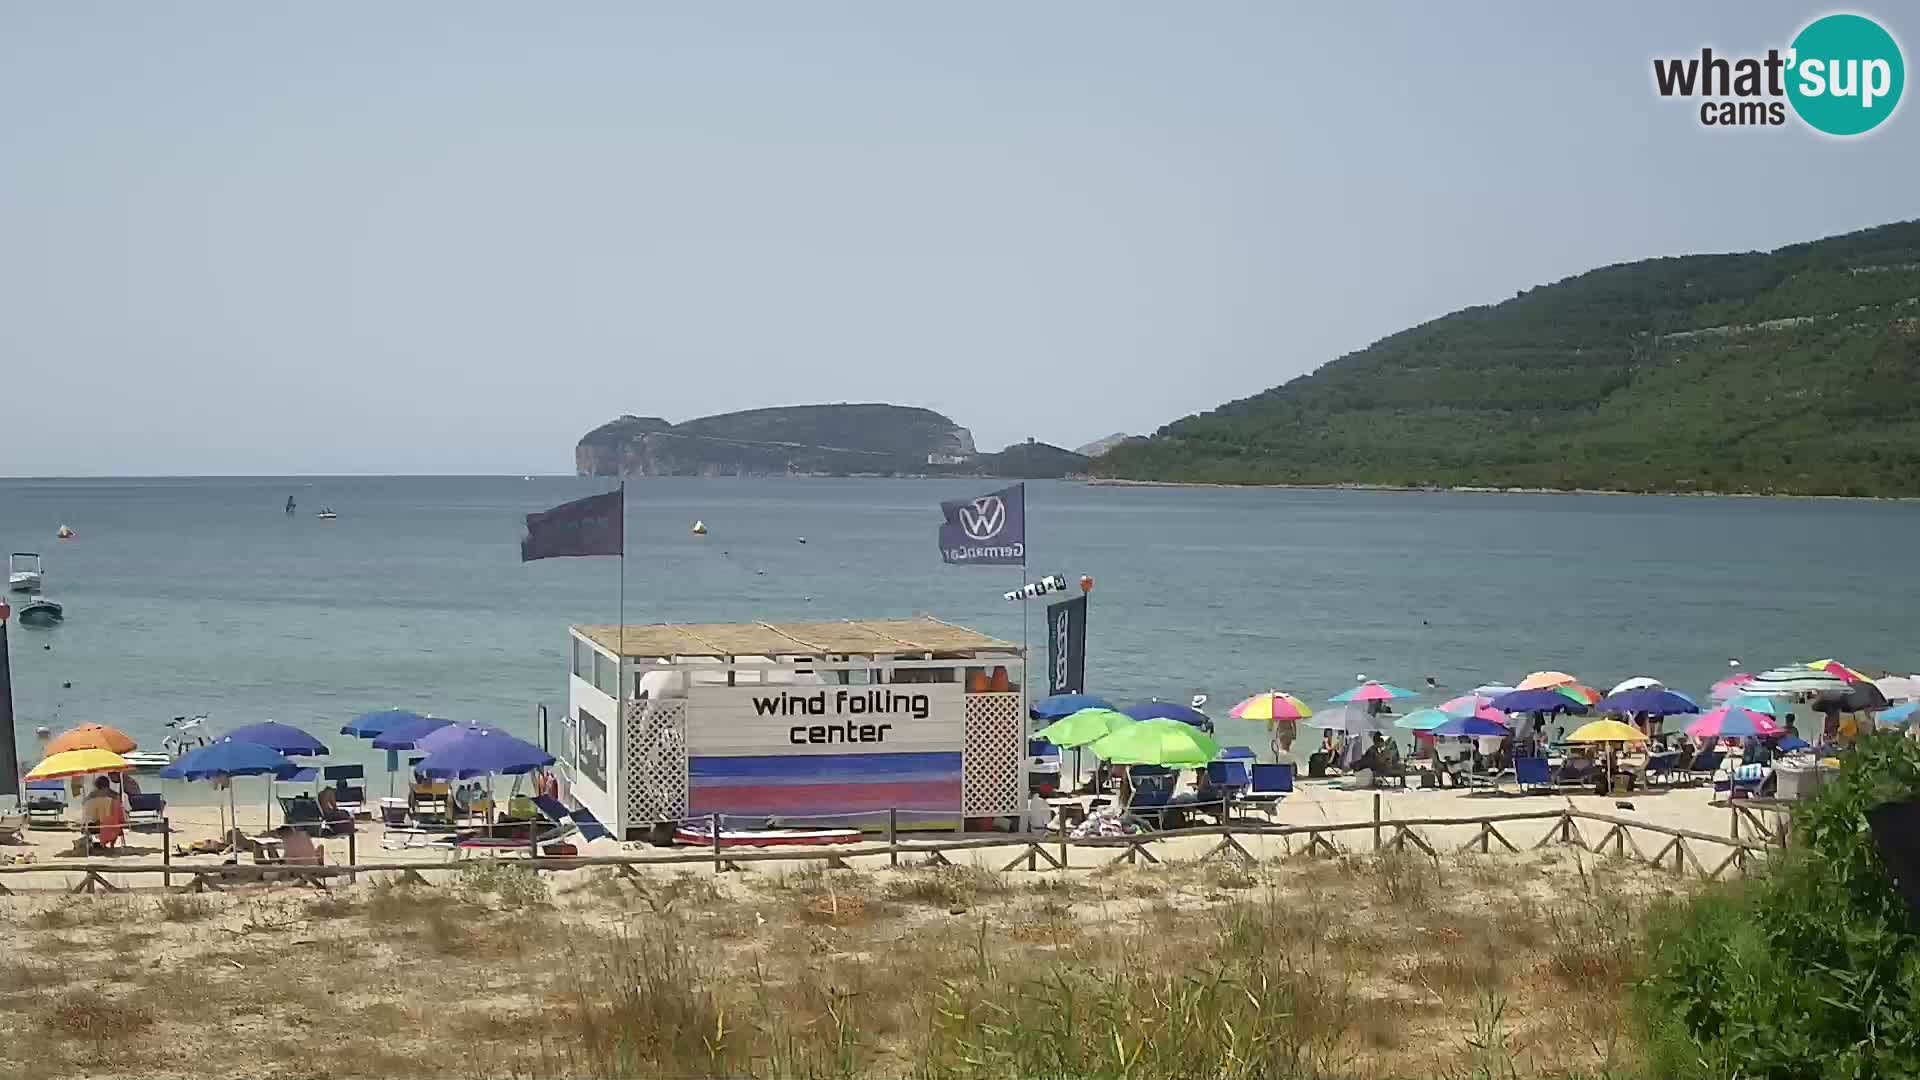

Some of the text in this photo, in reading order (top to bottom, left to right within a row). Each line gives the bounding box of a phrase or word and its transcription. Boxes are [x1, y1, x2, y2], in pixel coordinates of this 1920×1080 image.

[753, 690, 929, 719] wind foiling
[790, 720, 892, 744] center
